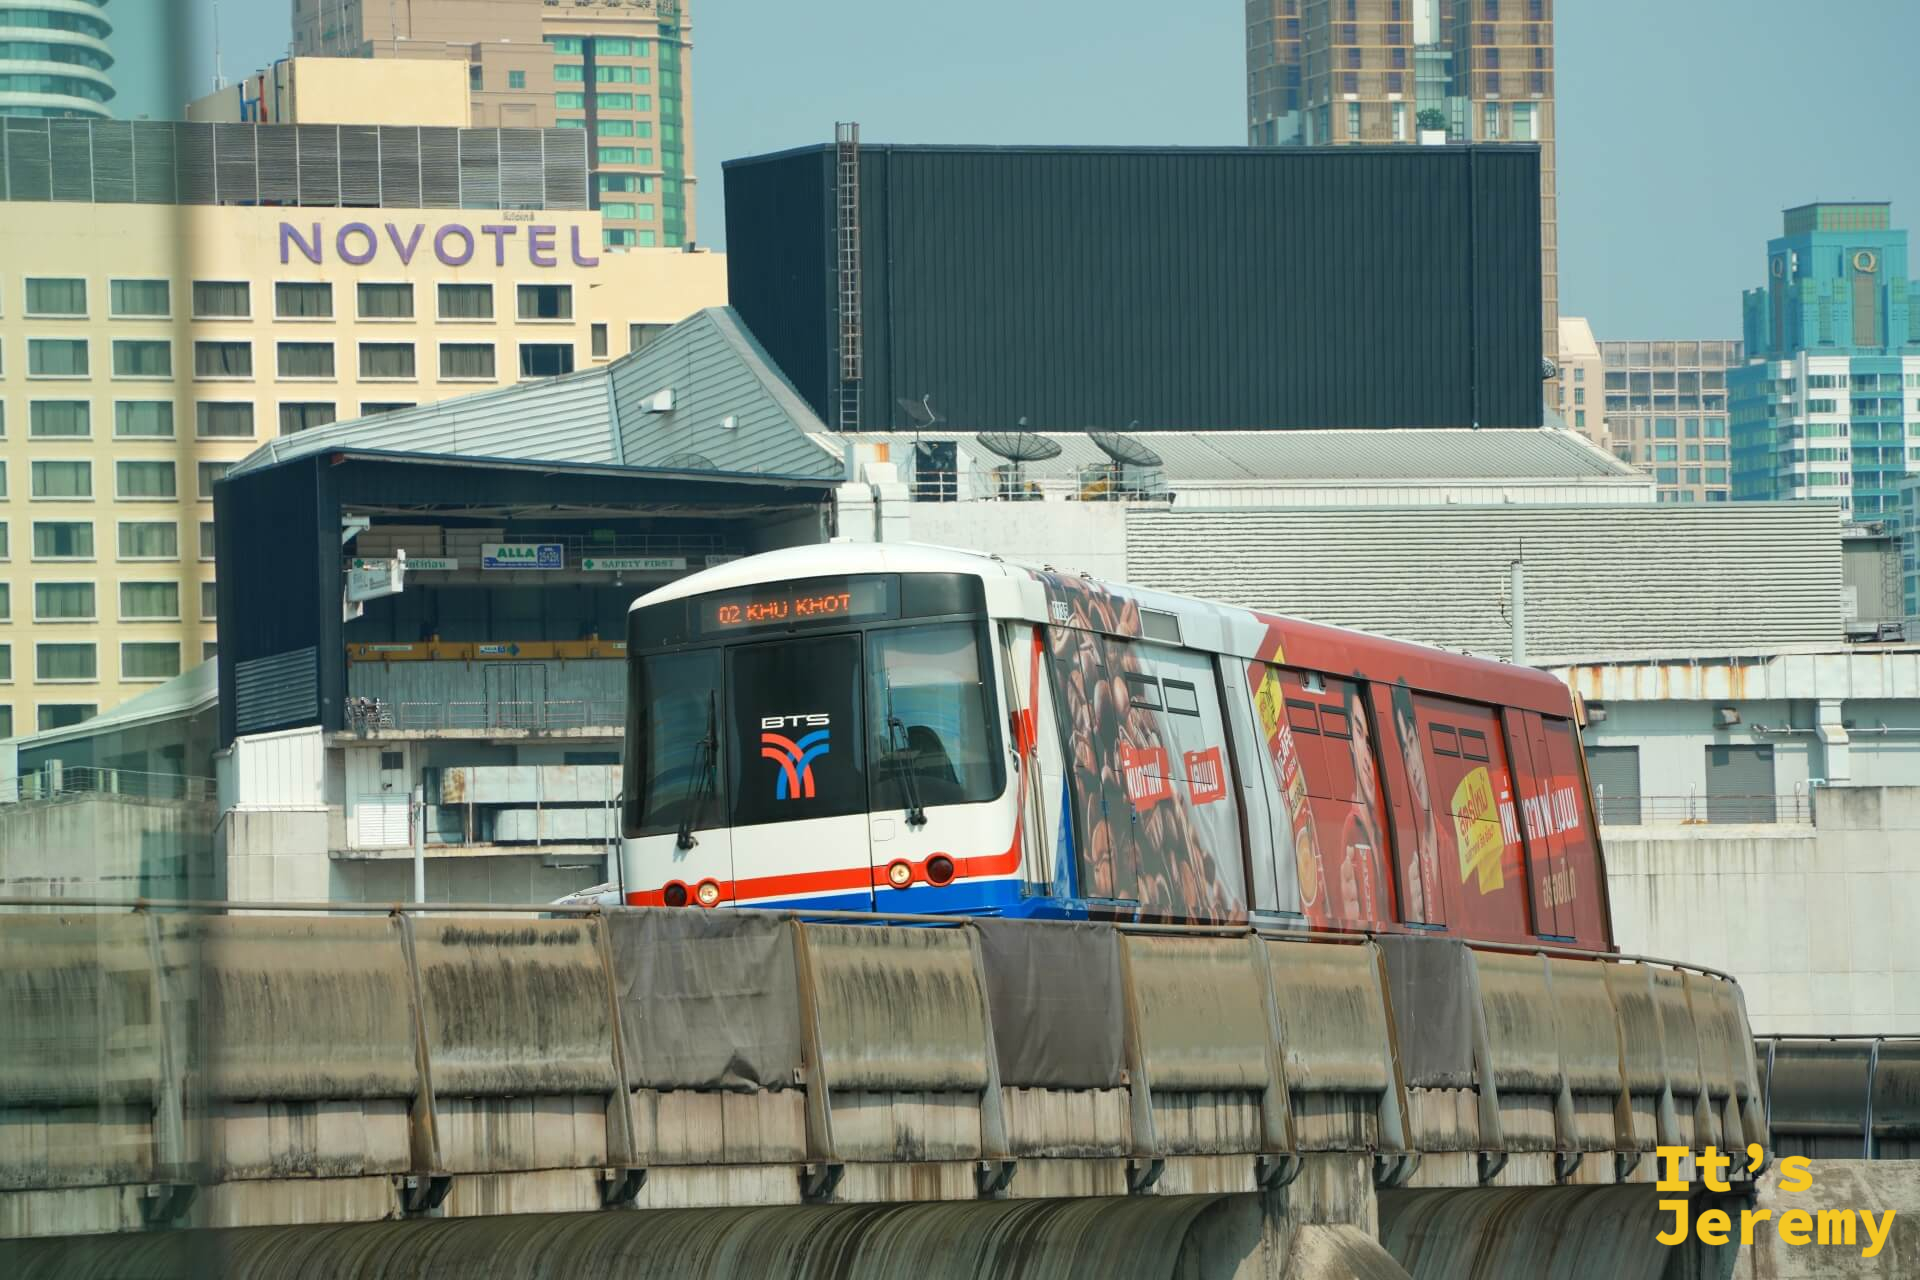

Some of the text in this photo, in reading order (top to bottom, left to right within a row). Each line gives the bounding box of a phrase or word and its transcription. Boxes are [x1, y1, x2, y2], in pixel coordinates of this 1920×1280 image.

[279, 222, 600, 267] NOVOTEL
[1853, 251, 1878, 273] Q
[497, 547, 536, 559] ALLA
[601, 559, 675, 569] SAFETY FIRST
[719, 594, 851, 624] 02 KHU KHOT
[761, 713, 830, 730] BTS
